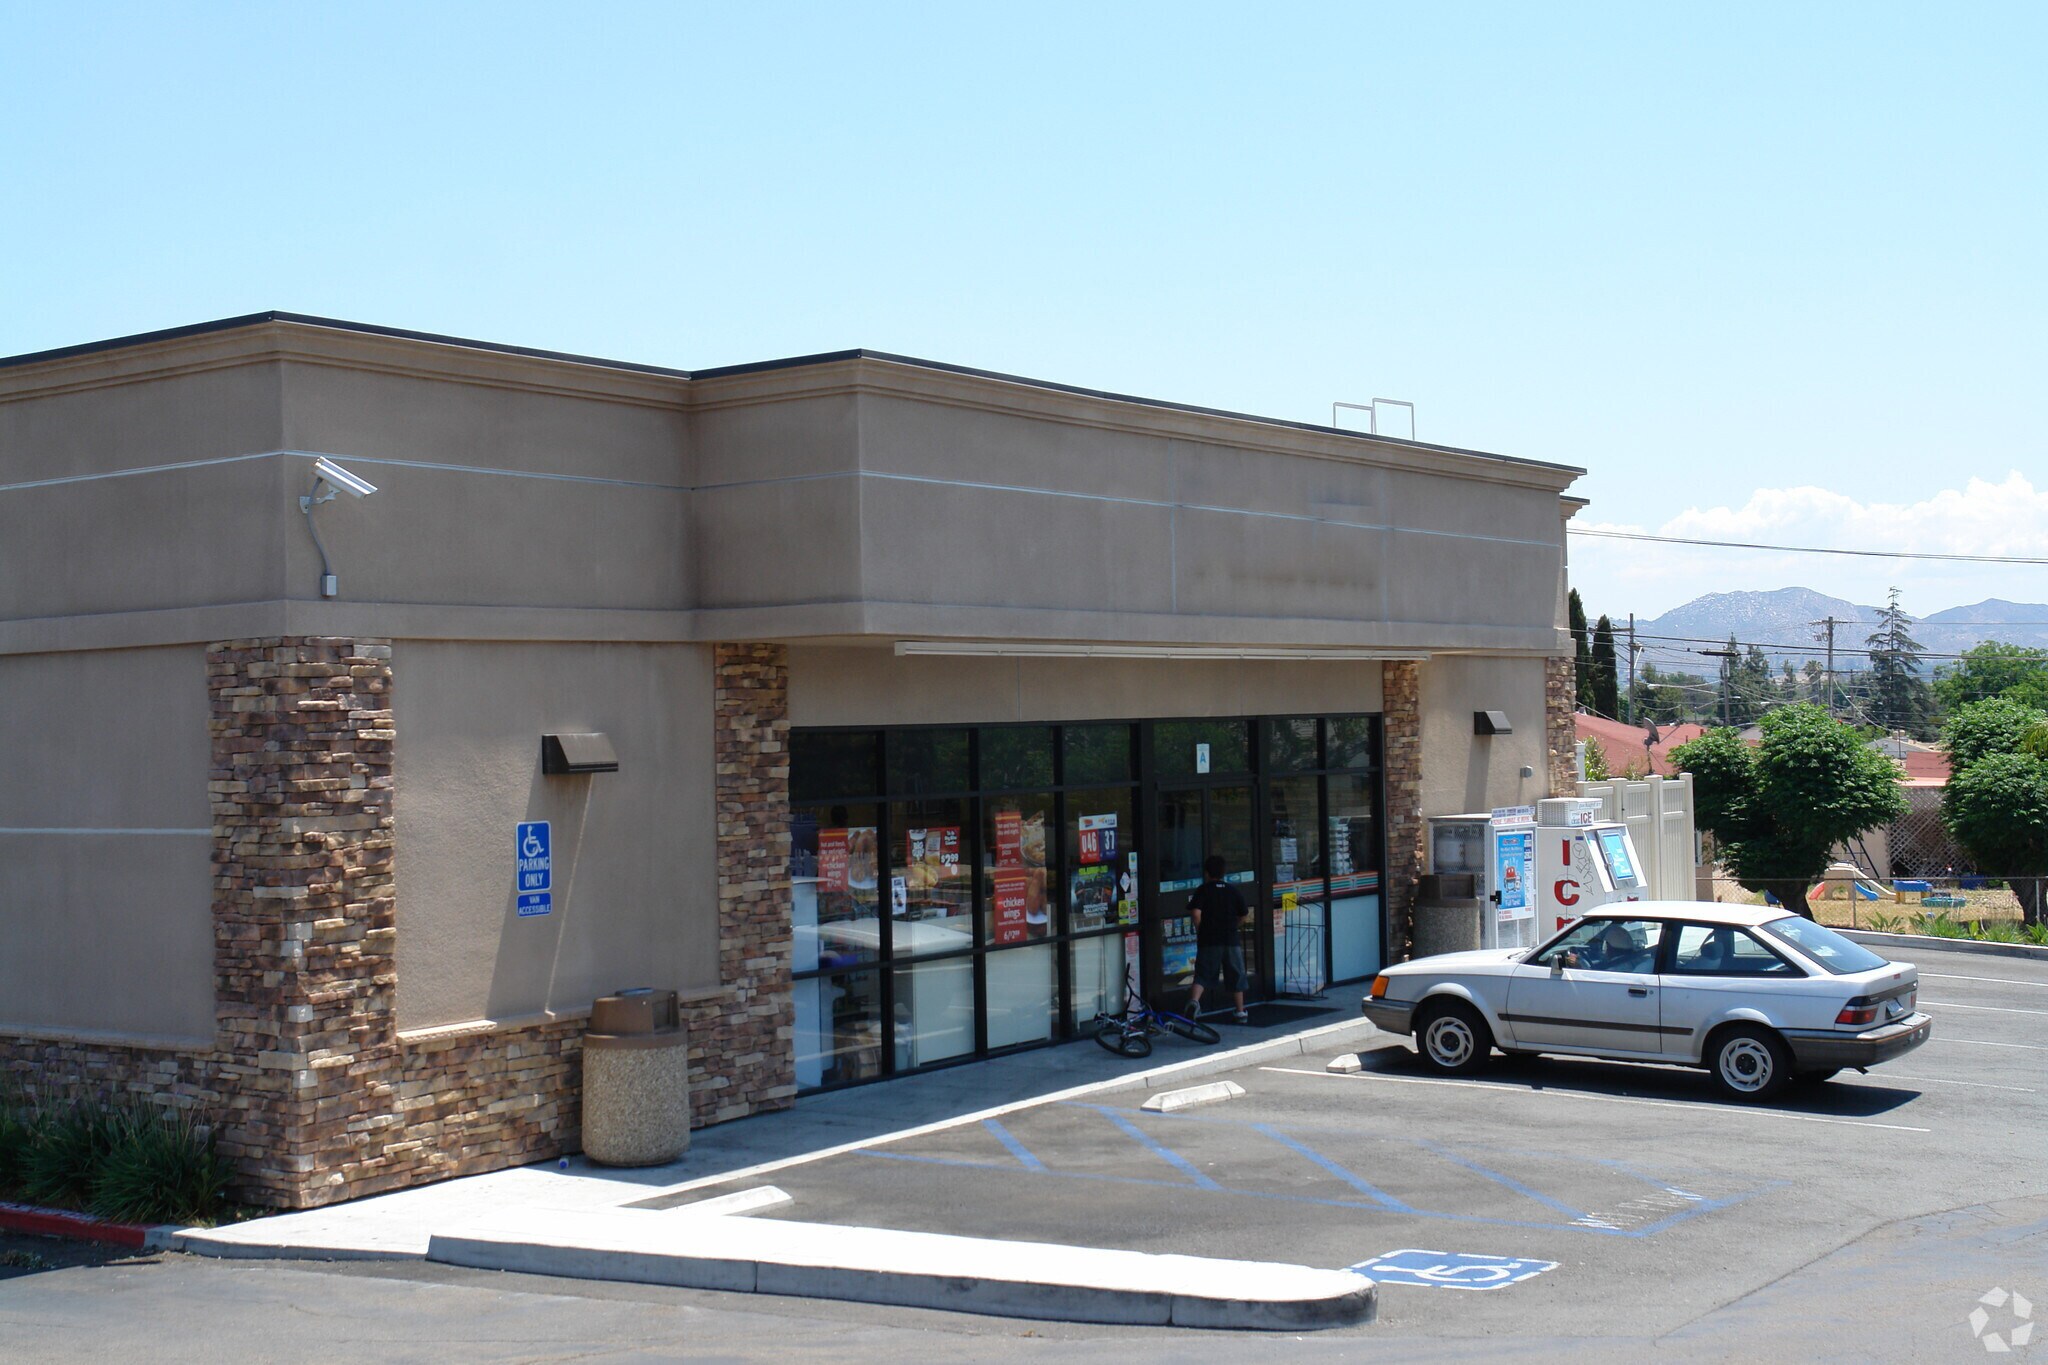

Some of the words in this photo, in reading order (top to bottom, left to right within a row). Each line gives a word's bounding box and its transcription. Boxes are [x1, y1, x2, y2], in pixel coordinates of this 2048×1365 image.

[1200, 752, 1206, 763] A
[1580, 811, 1592, 824] ICE
[1104, 830, 1115, 850] 37
[519, 856, 549, 872] PARKING
[525, 872, 543, 888] ONLY
[529, 895, 540, 904] VAN
[1003, 897, 1025, 908] chicken
[519, 904, 550, 914] ACCESSIBLE
[1003, 908, 1021, 920] wings
